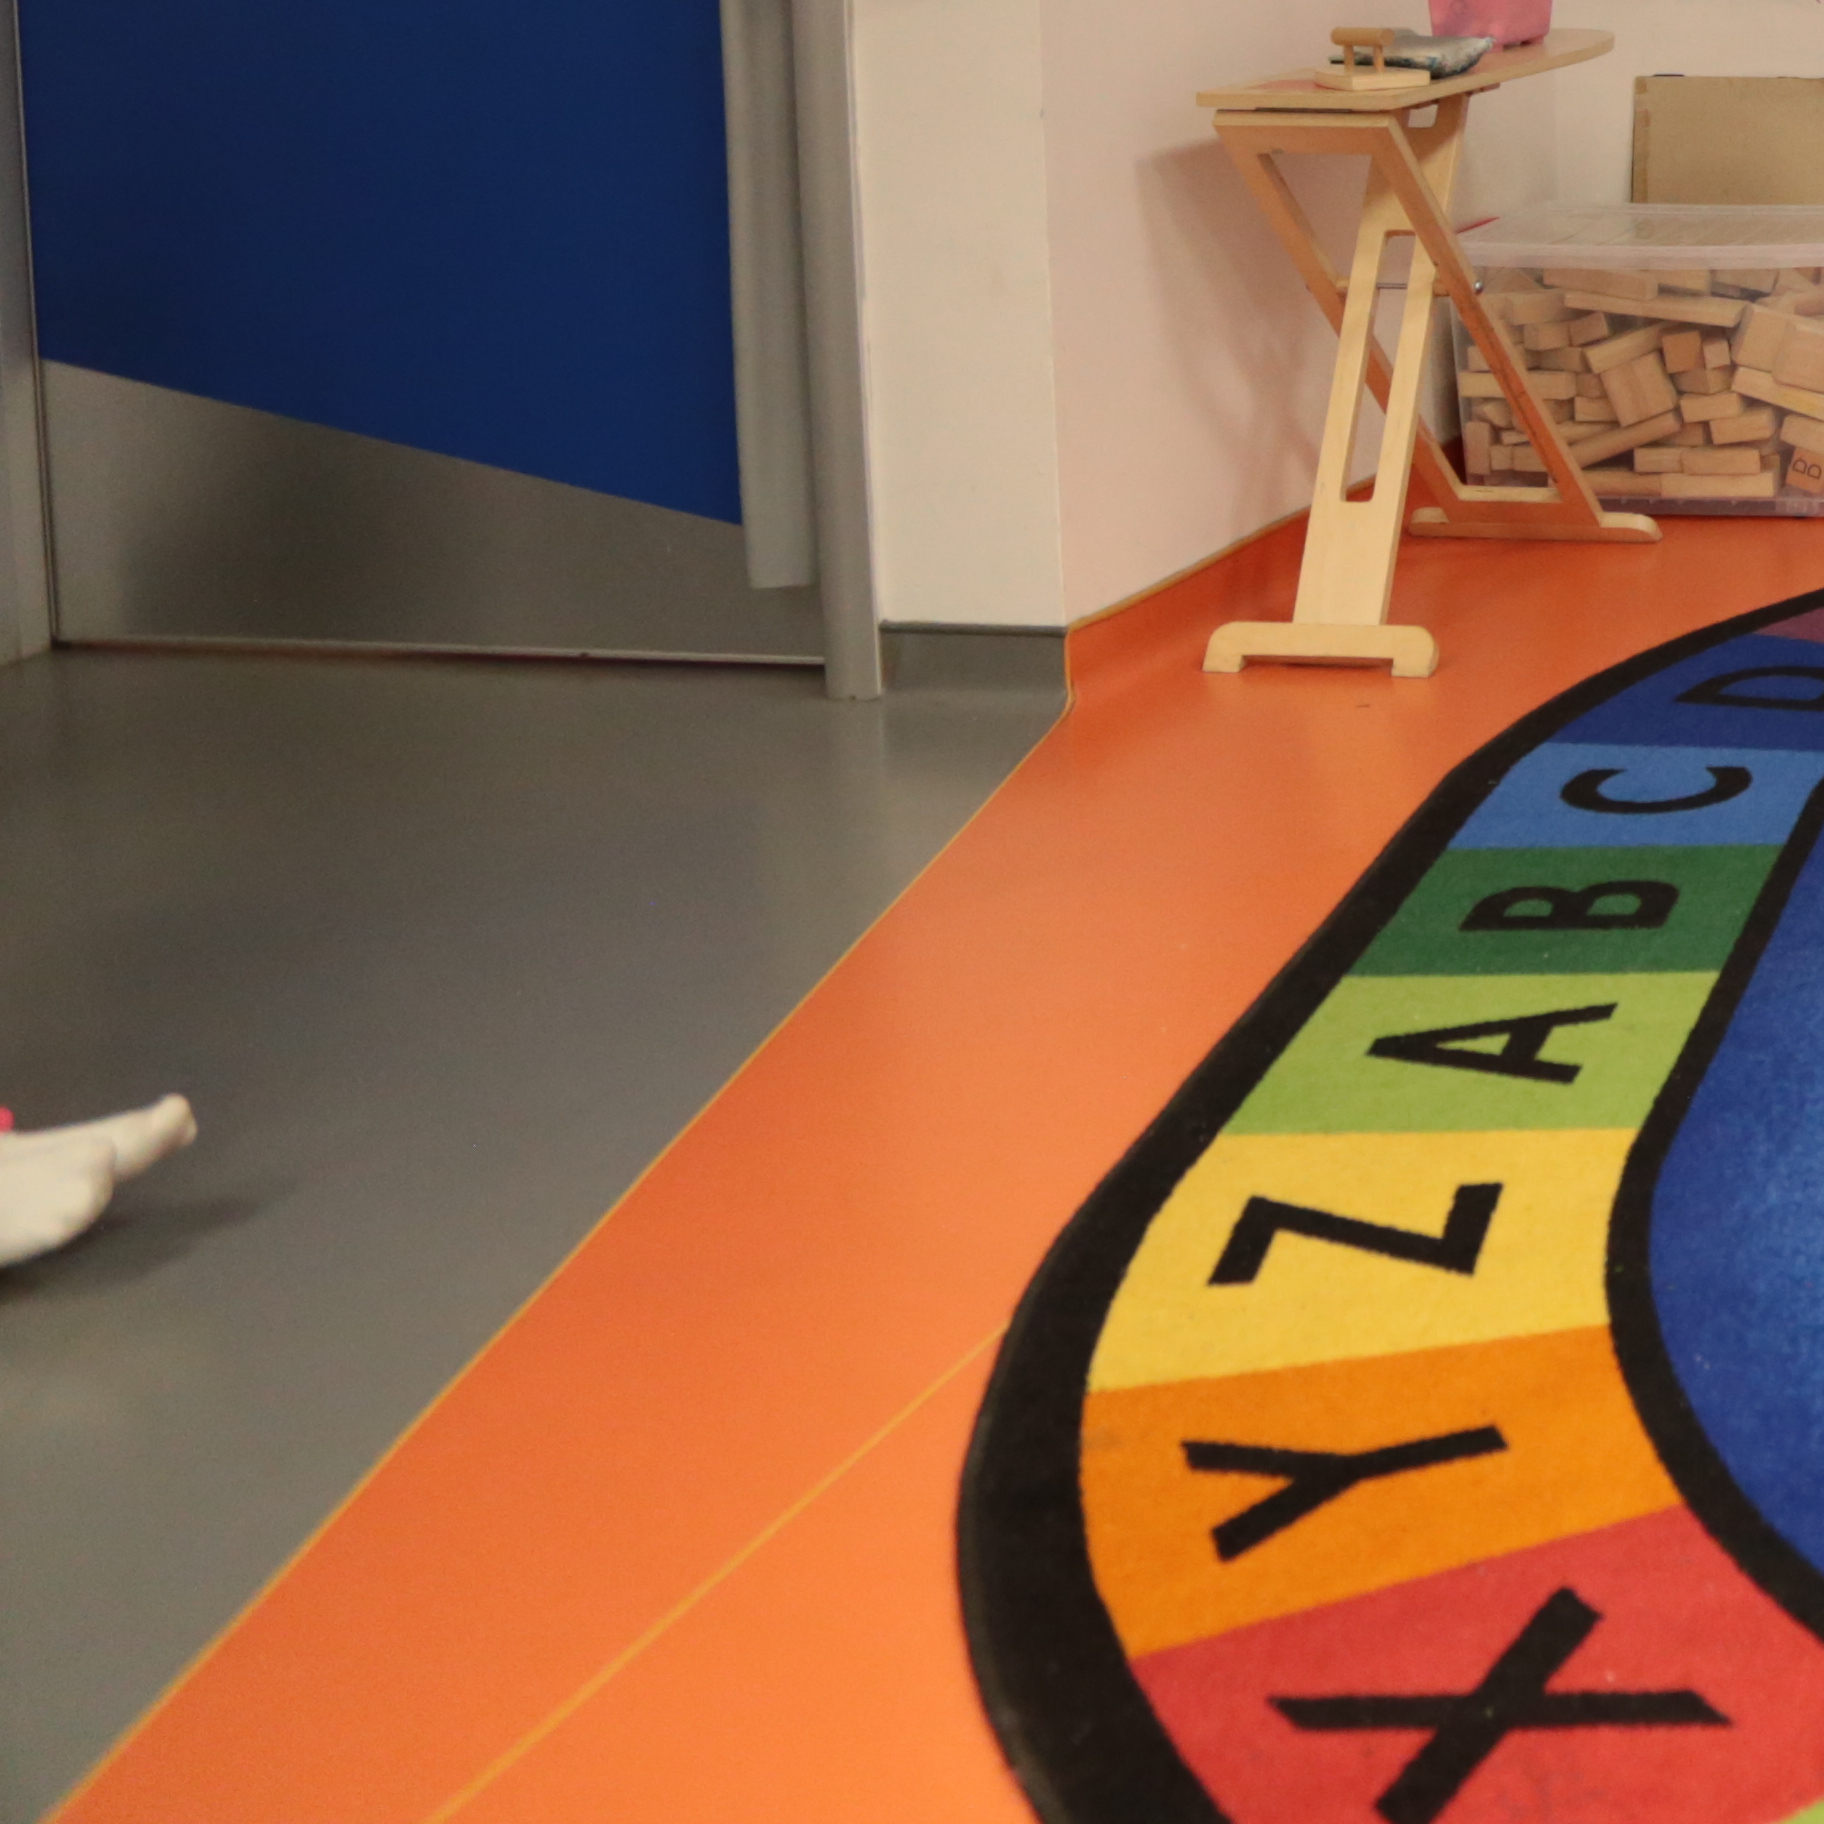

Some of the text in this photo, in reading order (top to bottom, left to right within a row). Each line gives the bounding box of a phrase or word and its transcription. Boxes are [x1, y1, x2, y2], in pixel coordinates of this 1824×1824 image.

[1559, 764, 1754, 816] C
[1459, 878, 1681, 933] B
[1365, 1002, 1618, 1084] A
[1206, 1182, 1504, 1288] Z
[1179, 1425, 1509, 1563] Y
[1264, 1586, 1734, 1824] X
